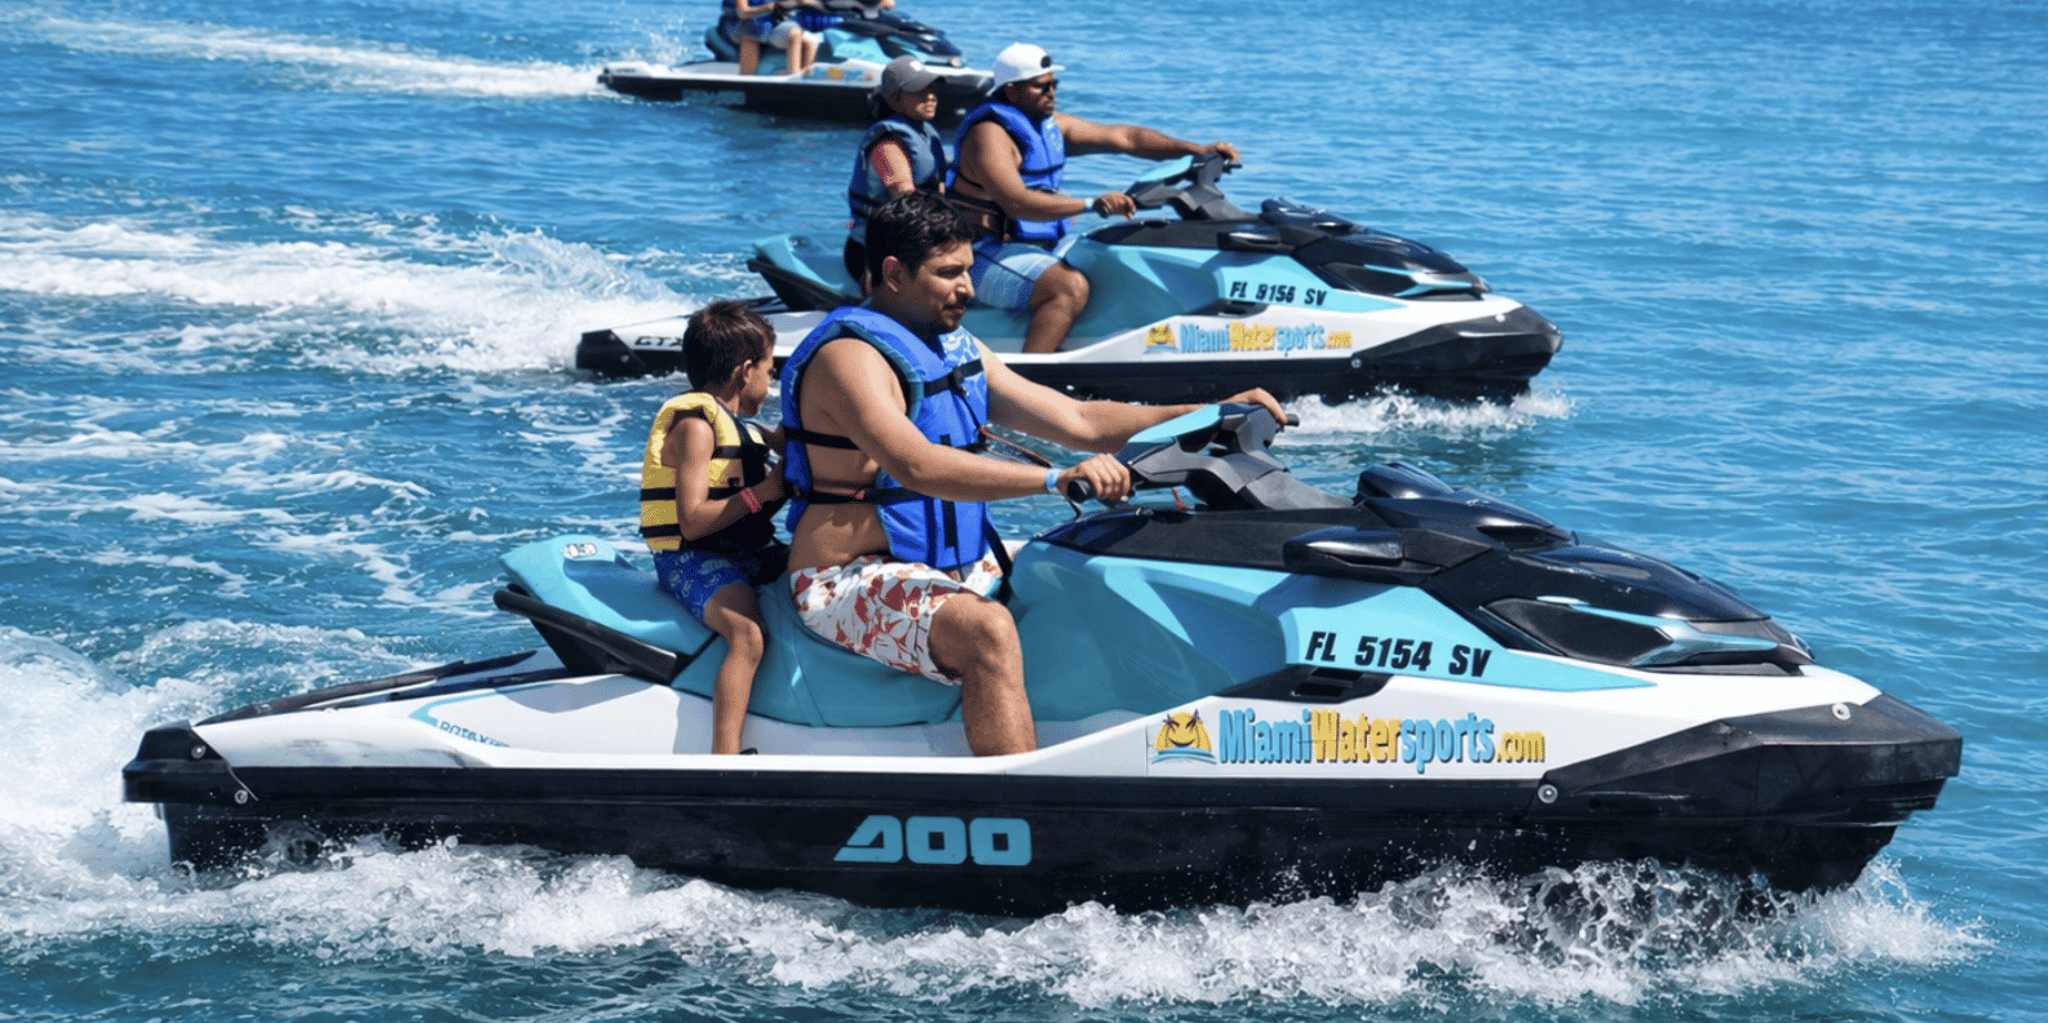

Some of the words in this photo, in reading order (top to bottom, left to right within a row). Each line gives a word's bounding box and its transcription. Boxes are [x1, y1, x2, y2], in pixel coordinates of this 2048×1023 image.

[1230, 281, 1248, 298] FL
[1304, 288, 1328, 306] SV
[1305, 631, 1336, 662] FL
[1354, 636, 1433, 672] 5154
[1448, 644, 1492, 678] SV
[1218, 708, 1546, 774] MiamiWatersports.com
